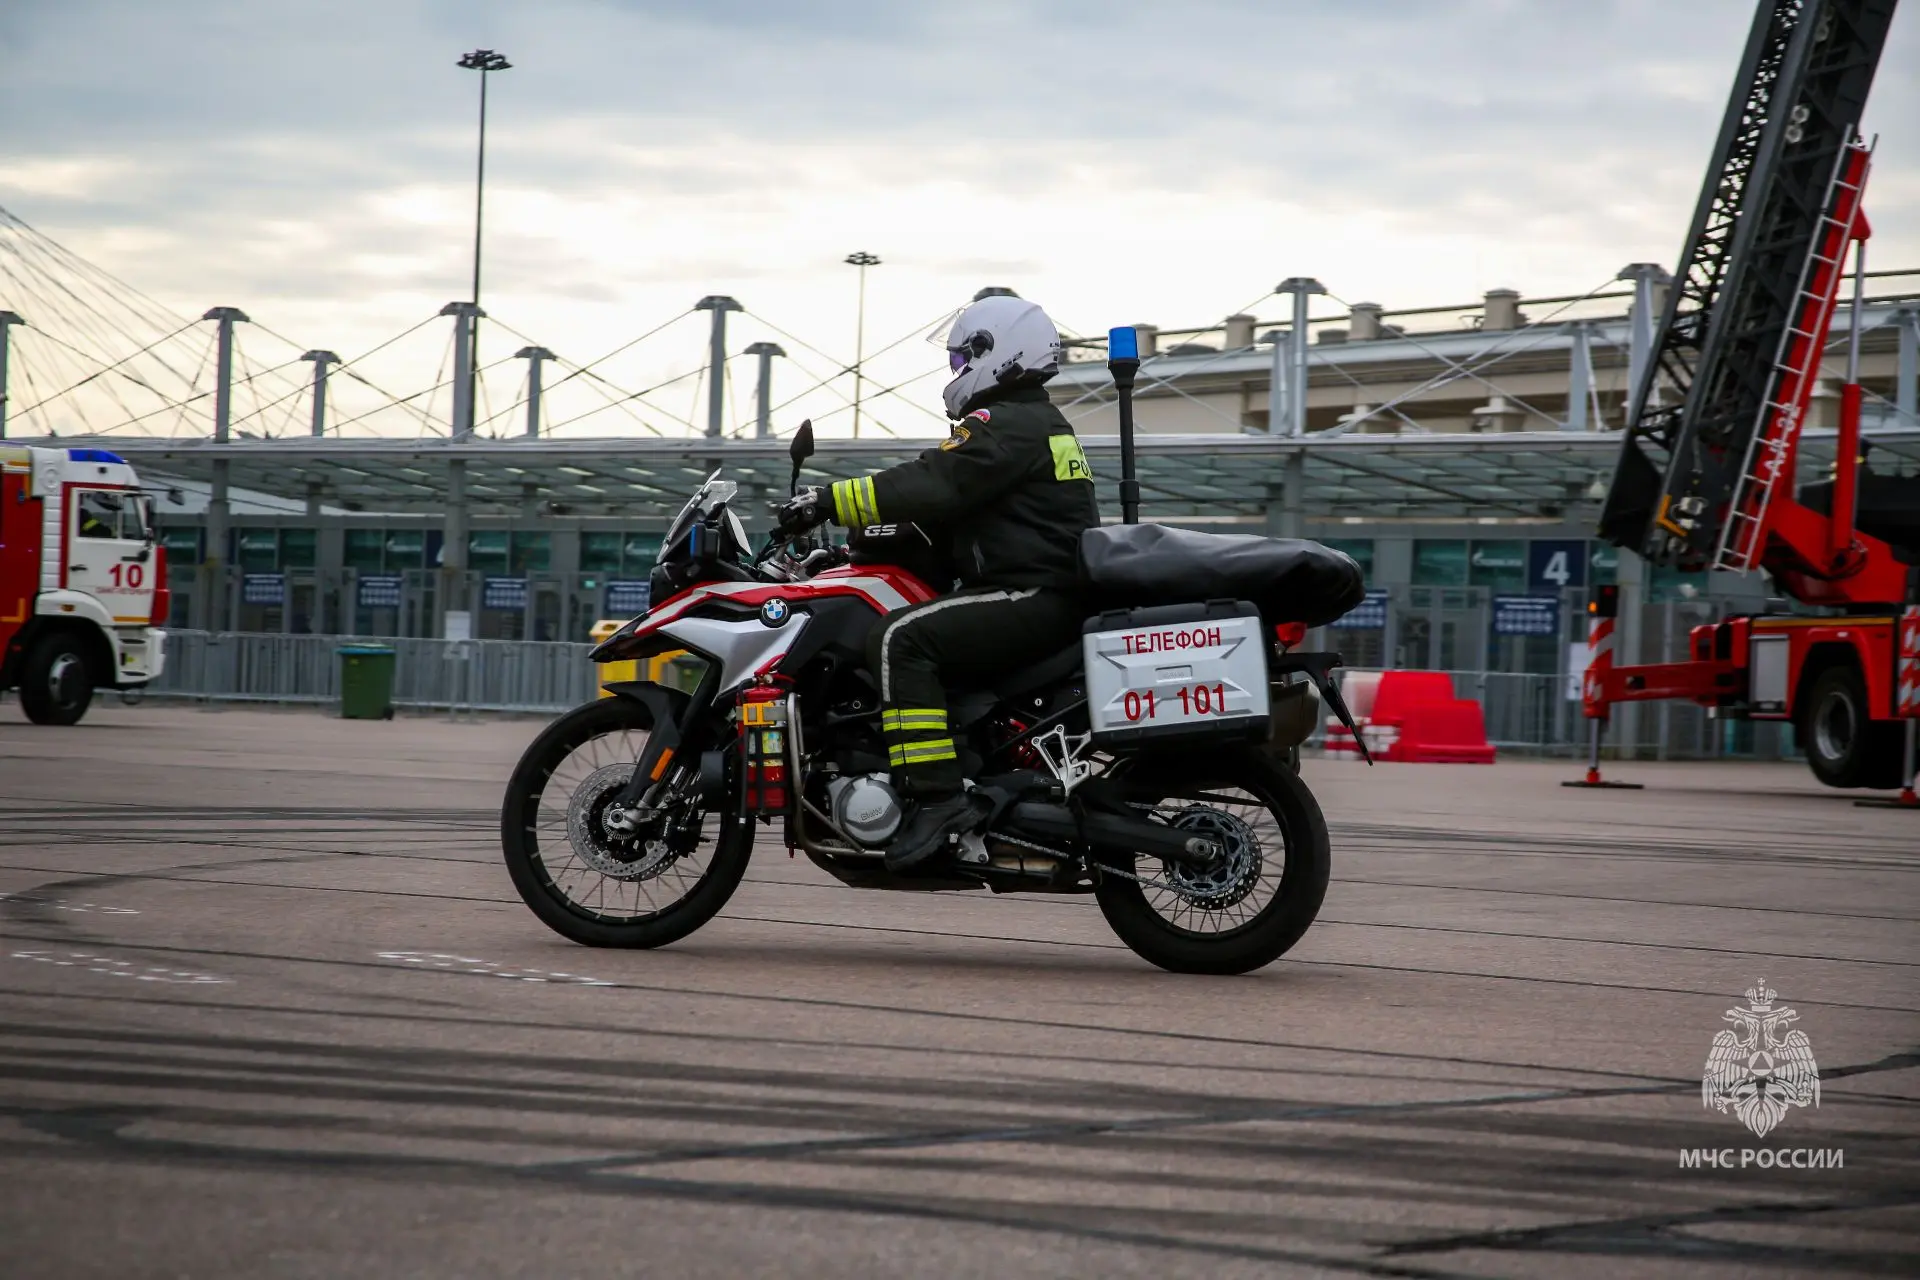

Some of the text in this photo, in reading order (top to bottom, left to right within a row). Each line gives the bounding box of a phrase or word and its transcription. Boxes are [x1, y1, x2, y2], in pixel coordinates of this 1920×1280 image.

[1068, 460, 1093, 480] РО
[864, 524, 898, 537] GS
[109, 563, 143, 588] 10
[1543, 550, 1571, 585] 4
[1122, 627, 1221, 655] ТЕЛЕФОН
[1124, 683, 1226, 721] 01 101
